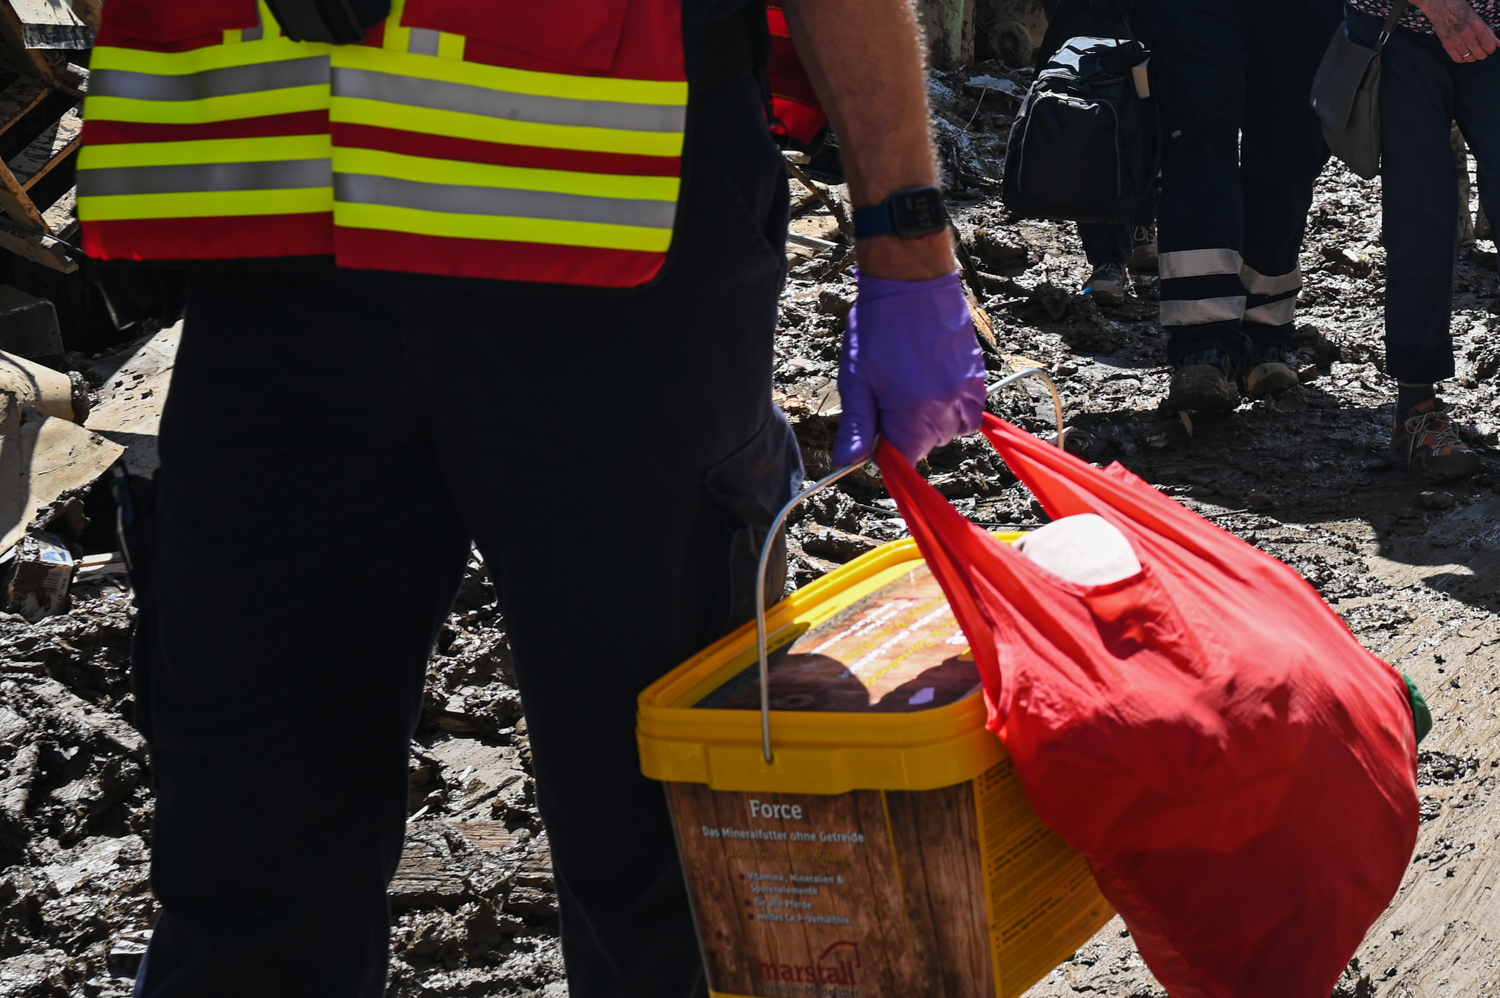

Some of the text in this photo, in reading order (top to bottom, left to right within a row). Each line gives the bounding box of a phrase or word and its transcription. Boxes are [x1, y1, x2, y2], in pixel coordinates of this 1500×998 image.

[749, 800, 803, 819] Force
[702, 825, 865, 844] Das Mineralfutter ohne Getreide
[790, 873, 834, 884] Mineralien
[836, 874, 844, 884] &
[756, 960, 857, 986] marstall
